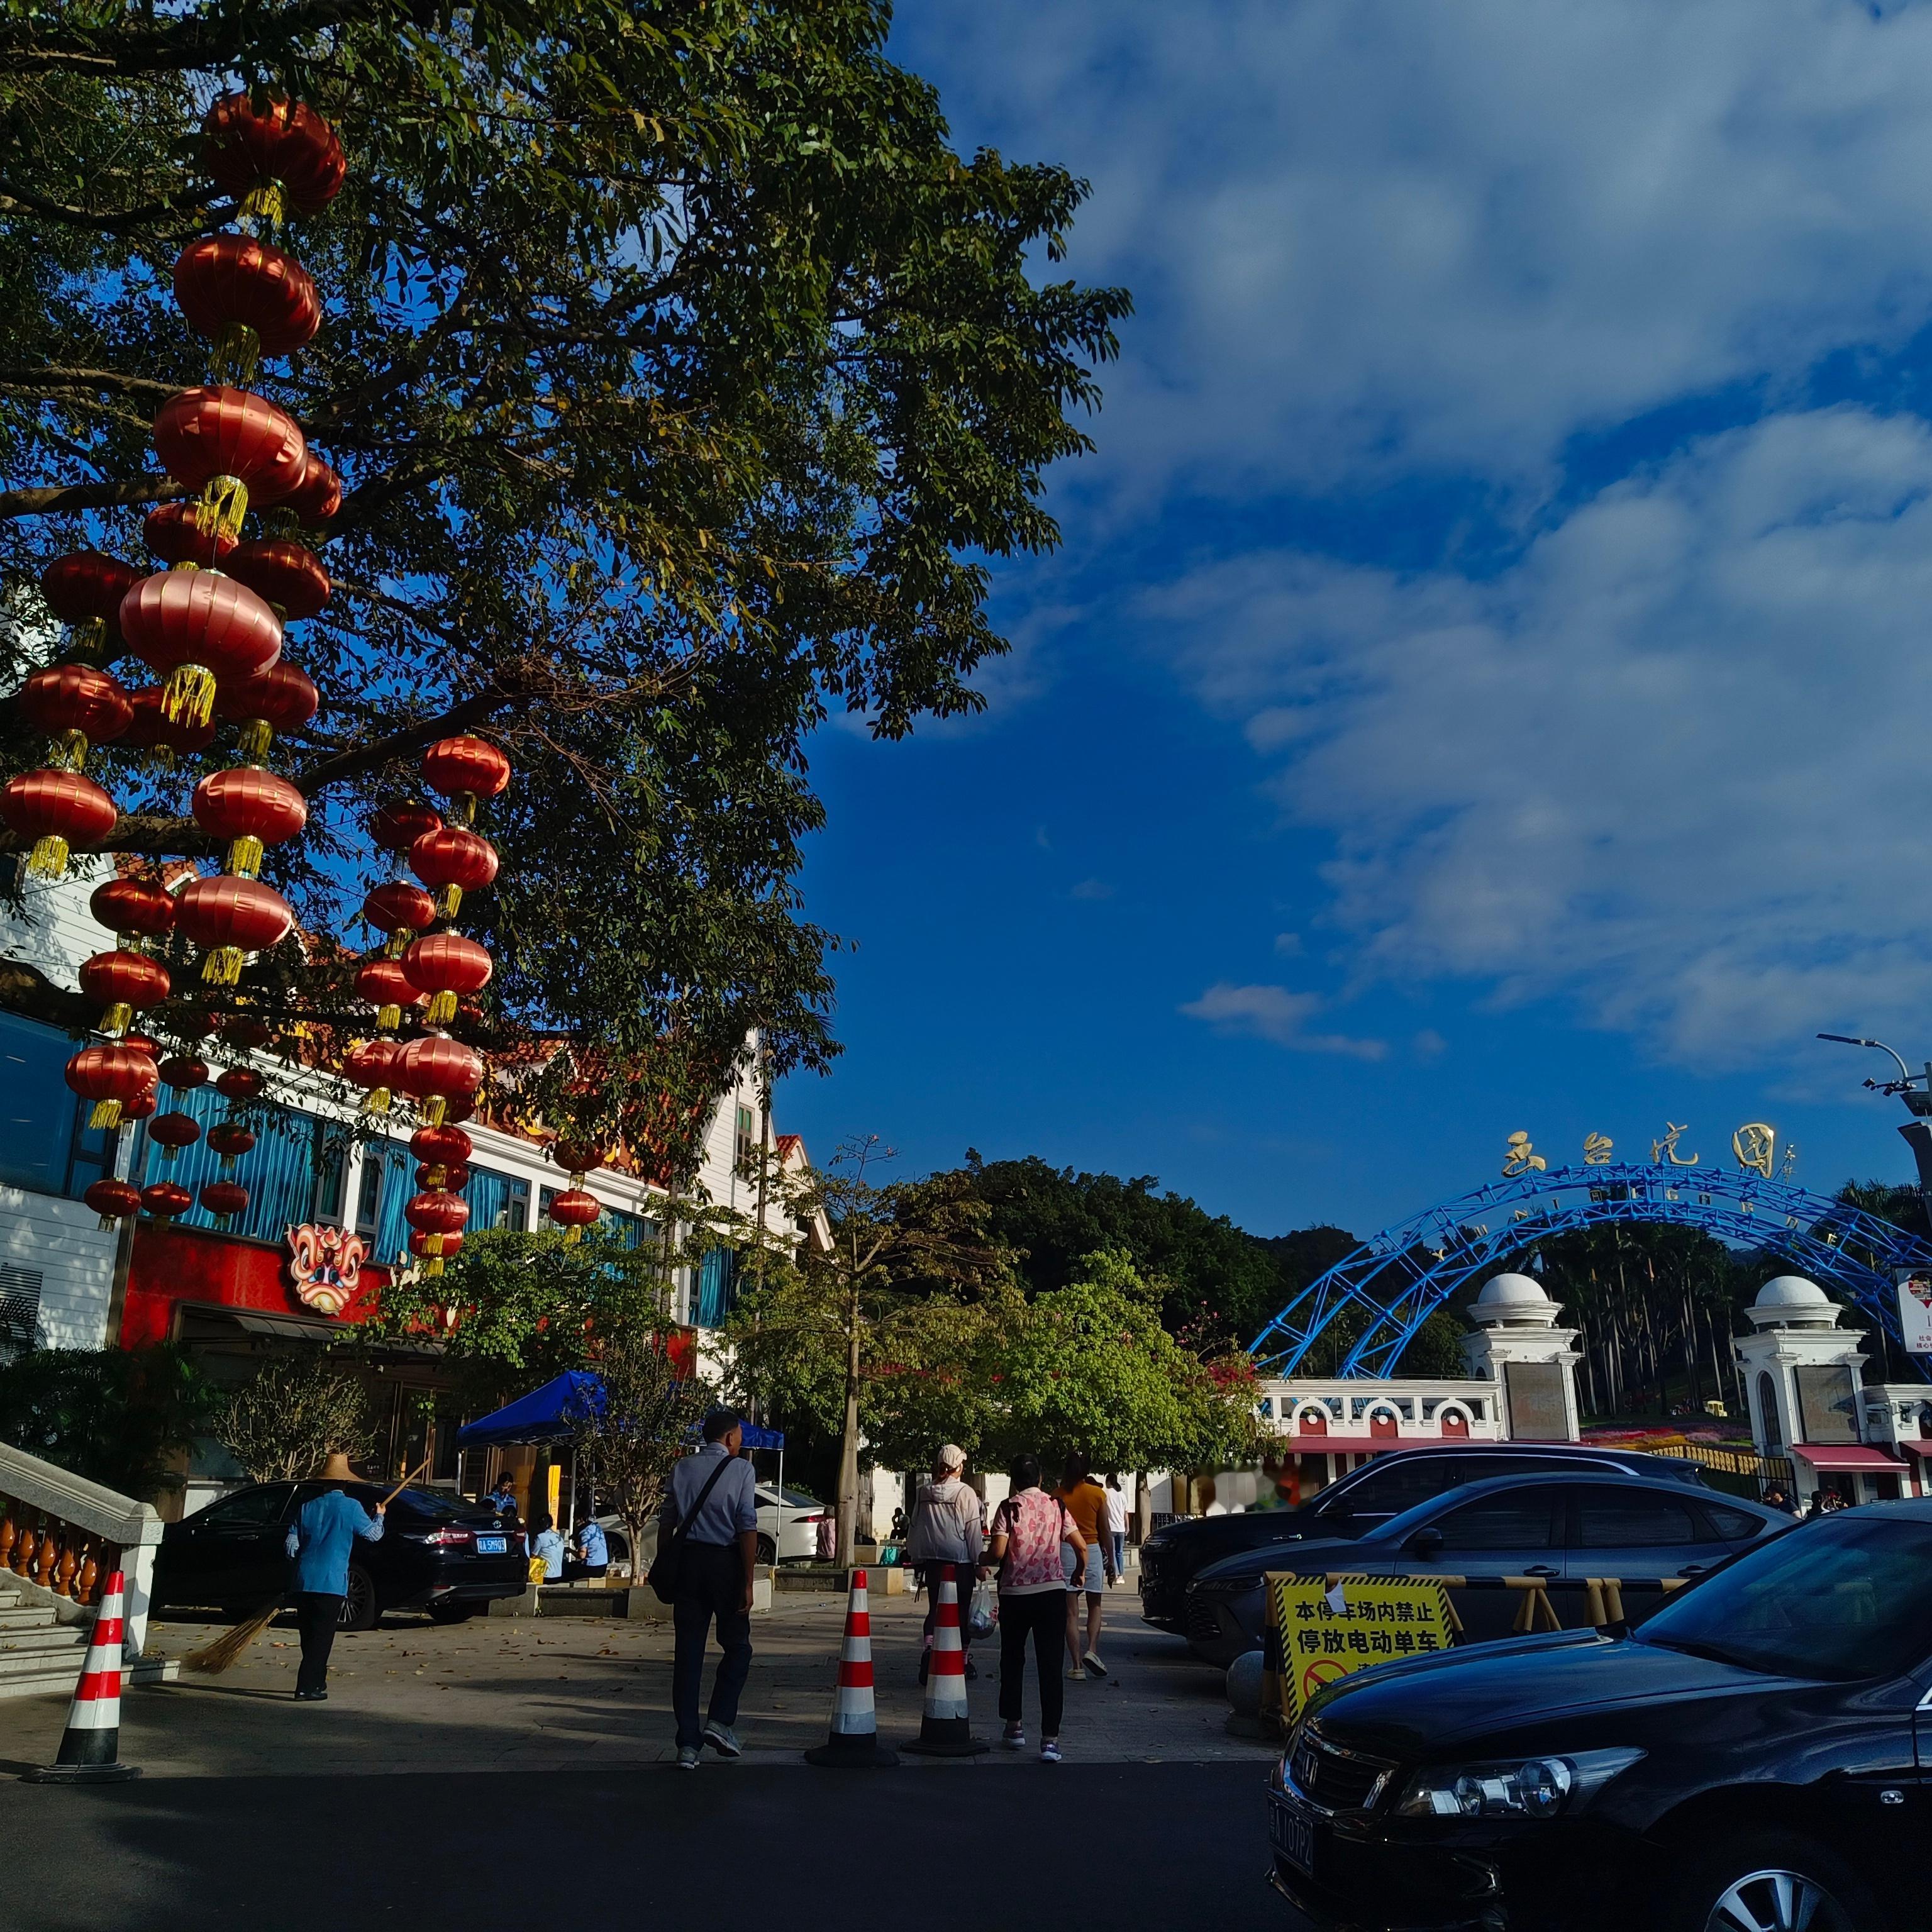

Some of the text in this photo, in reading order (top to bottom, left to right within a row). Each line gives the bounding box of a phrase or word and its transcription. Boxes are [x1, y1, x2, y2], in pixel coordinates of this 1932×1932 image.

[1295, 1601, 1435, 1623] 本停车场内禁止
[1297, 1629, 1440, 1654] 停放电动单车
